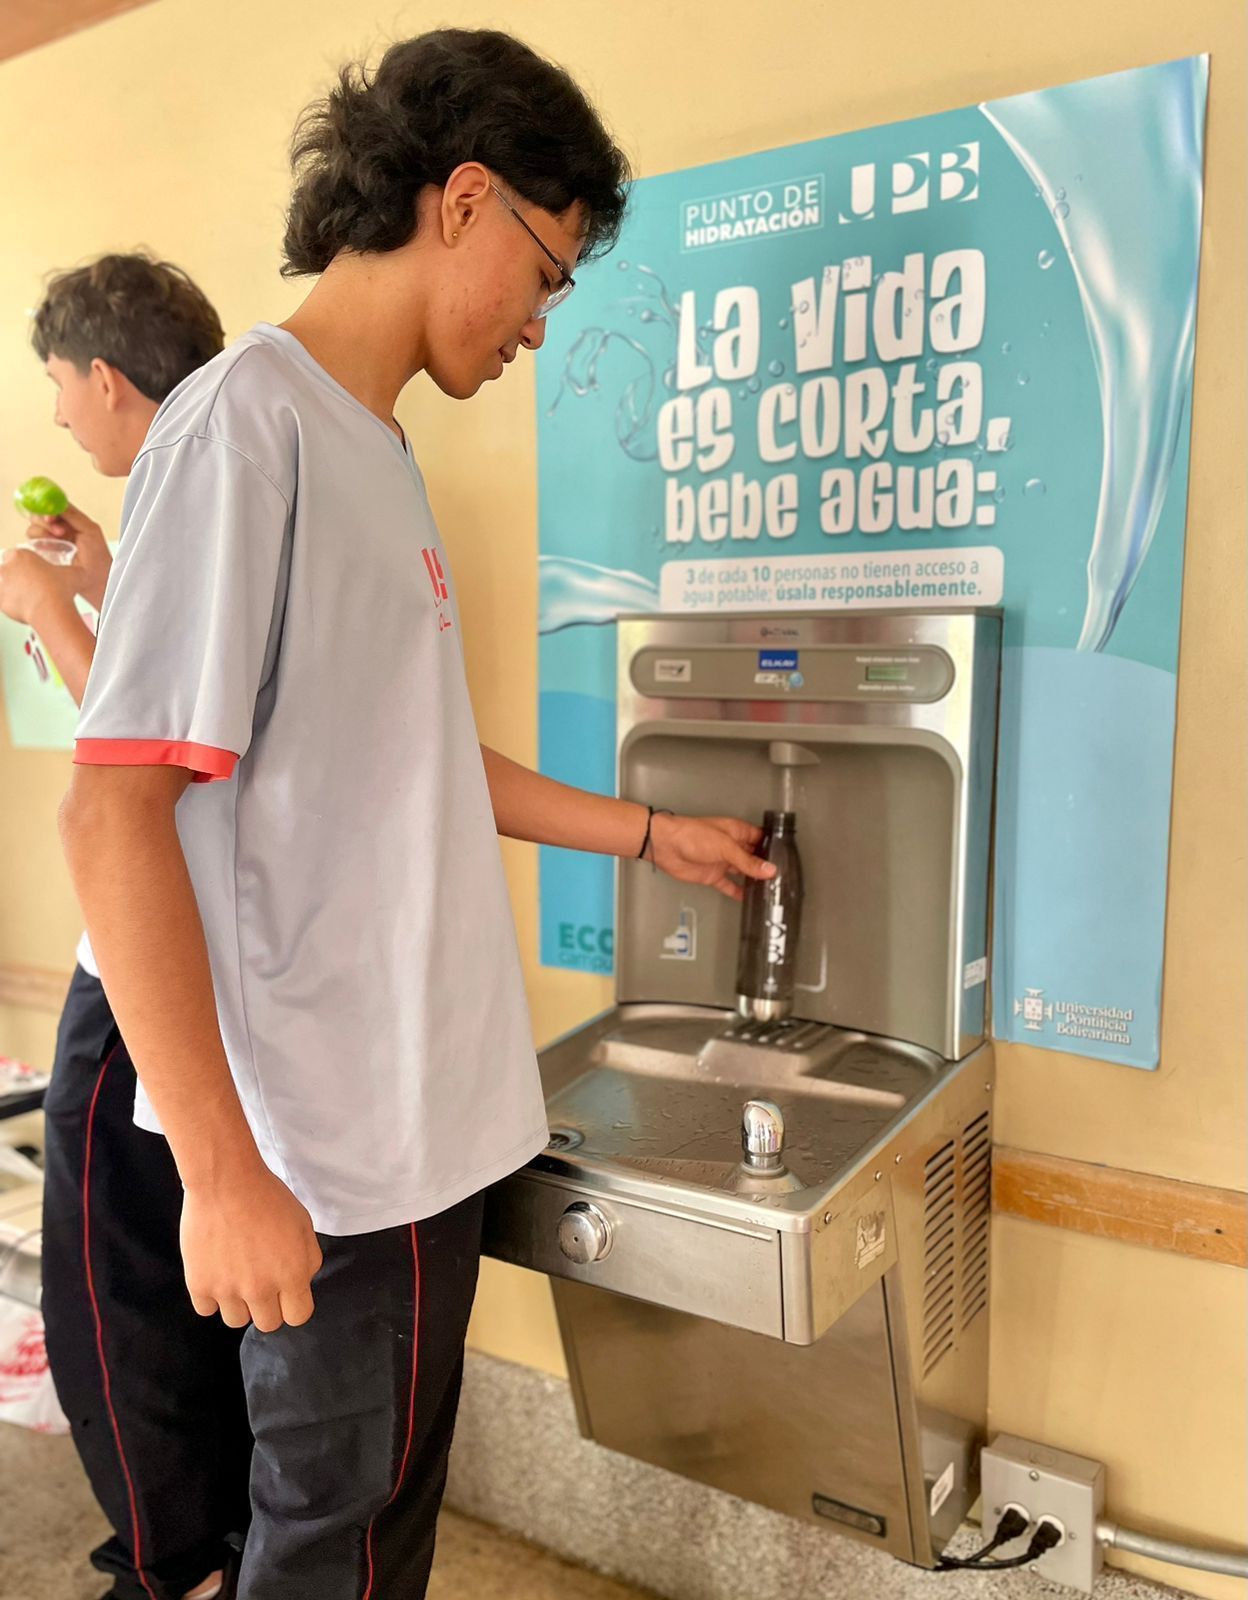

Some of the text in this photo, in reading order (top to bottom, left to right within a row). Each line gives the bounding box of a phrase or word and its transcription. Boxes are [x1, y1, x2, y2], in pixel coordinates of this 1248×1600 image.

[686, 180, 819, 228] PUNTO DE
[685, 205, 819, 248] HIDRATACIÓN
[676, 248, 986, 391] La Vida
[657, 386, 735, 473] es
[665, 472, 799, 543] bebe
[686, 560, 979, 586] 3 de cada 10 personas no tienen acceso a
[683, 590, 713, 608] agua
[776, 583, 817, 601] úsala
[822, 579, 983, 605] responsablemente.
[1055, 1000, 1133, 1021] Universidad
[1066, 1012, 1127, 1032] Pontificia
[1056, 1022, 1131, 1044] Bolivariana
